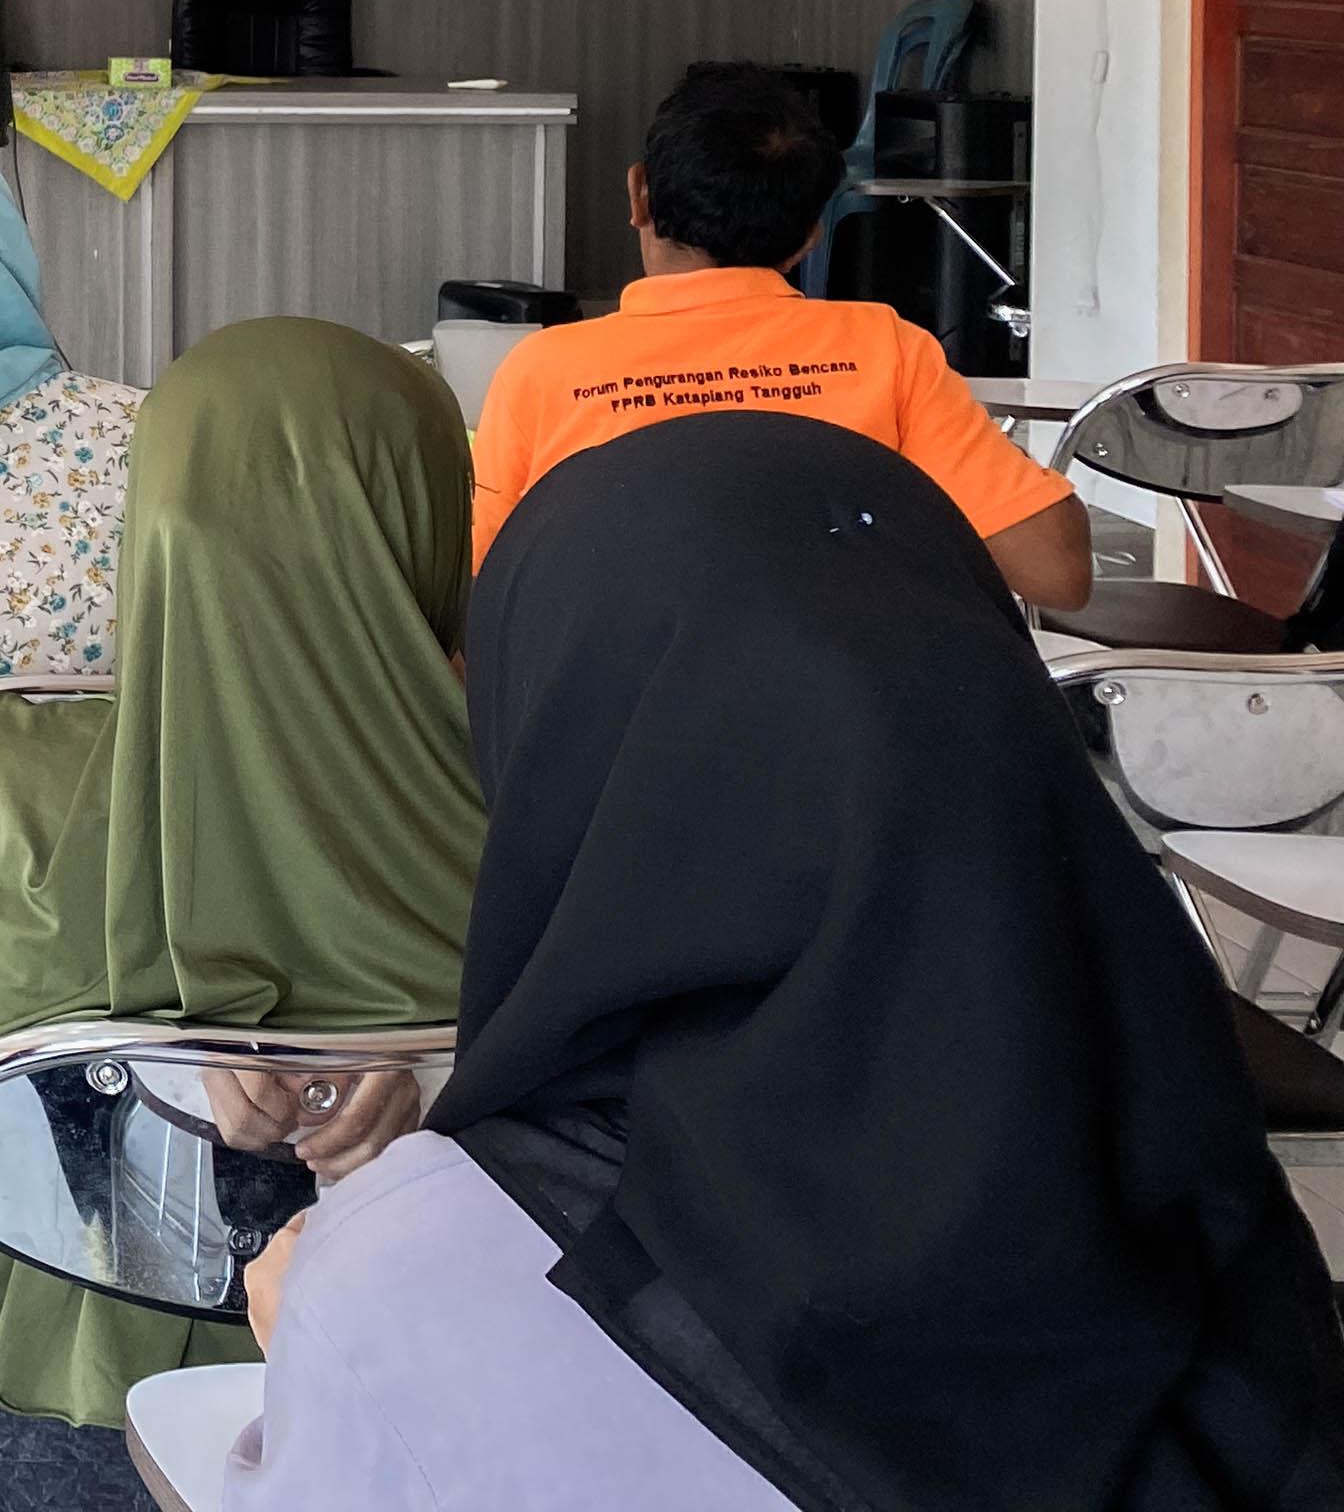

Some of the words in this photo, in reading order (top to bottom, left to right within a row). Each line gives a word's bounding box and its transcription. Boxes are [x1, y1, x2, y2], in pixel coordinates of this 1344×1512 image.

[573, 382, 618, 400] Forum
[623, 370, 723, 389] Pengurangan
[729, 365, 782, 379] Resiko
[789, 361, 858, 376] Bencana
[611, 394, 656, 412] FPRB
[663, 389, 744, 407] Katapiang
[750, 382, 822, 400] Tangguh
